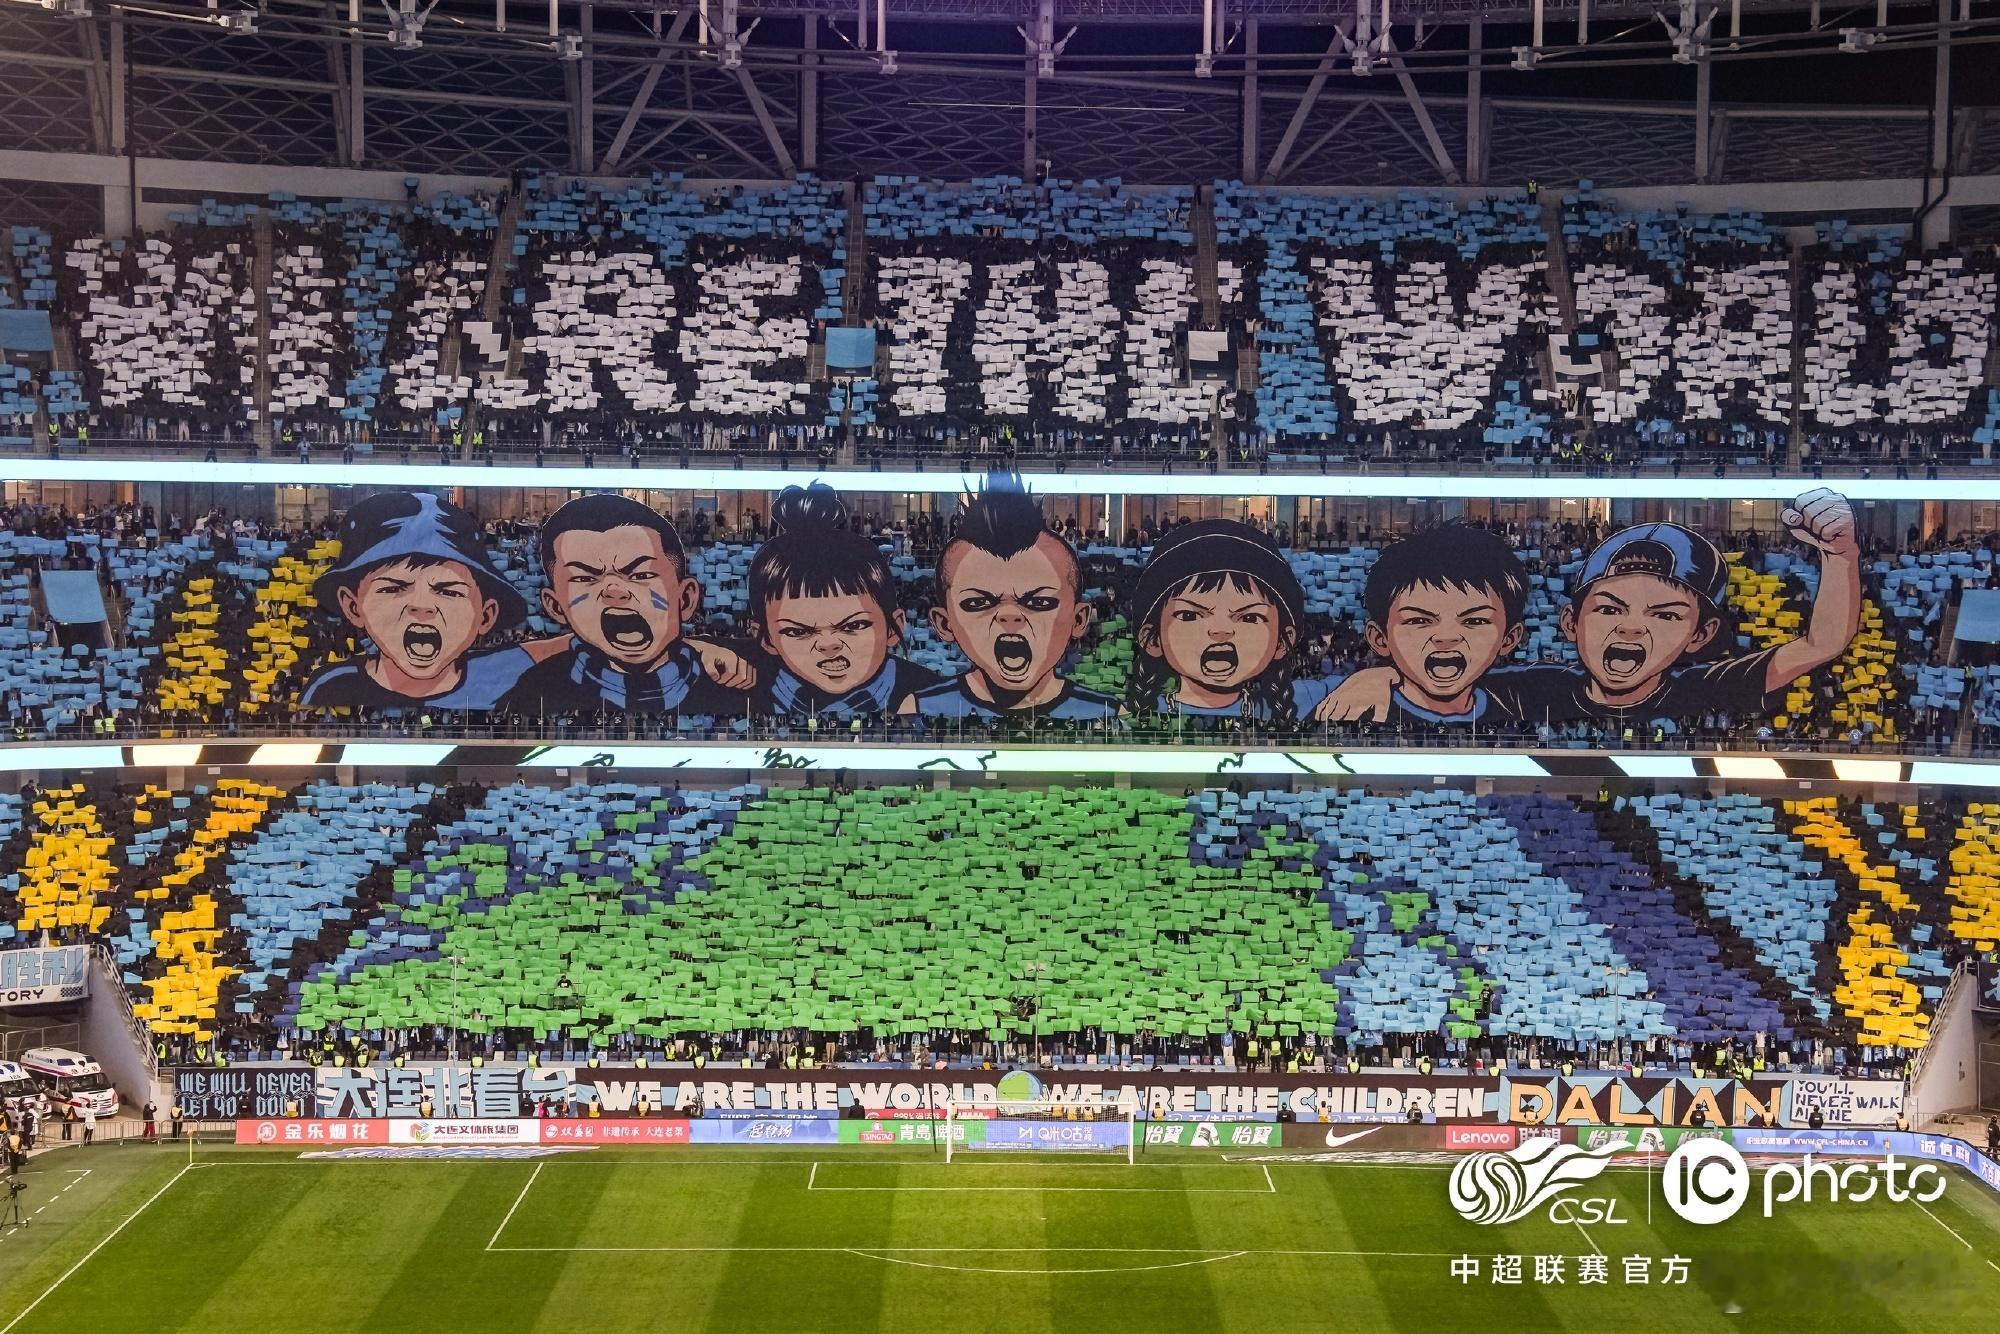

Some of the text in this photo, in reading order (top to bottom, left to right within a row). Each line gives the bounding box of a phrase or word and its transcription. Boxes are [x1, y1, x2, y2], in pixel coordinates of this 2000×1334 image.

[388, 250, 810, 415] ARE
[878, 256, 1243, 423] THE
[180, 1072, 311, 1095] WE WILL NEVER
[324, 1068, 568, 1118] 大连北看台
[1798, 1081, 1854, 1095] YOU'LL
[181, 1095, 210, 1118] LET
[593, 1081, 661, 1111] WE
[673, 1081, 755, 1111] ARE
[765, 1082, 838, 1110] THE
[849, 1082, 998, 1110] WORLD
[1116, 1085, 1195, 1113] ARE
[1207, 1086, 1279, 1113] THE
[1290, 1086, 1484, 1118] CHILDREN
[1509, 1083, 1782, 1128] DALIAN
[1796, 1093, 1900, 1109] NEVER WALK
[284, 1123, 369, 1140] 金乐烟花
[1452, 1130, 1510, 1144] Lenovo
